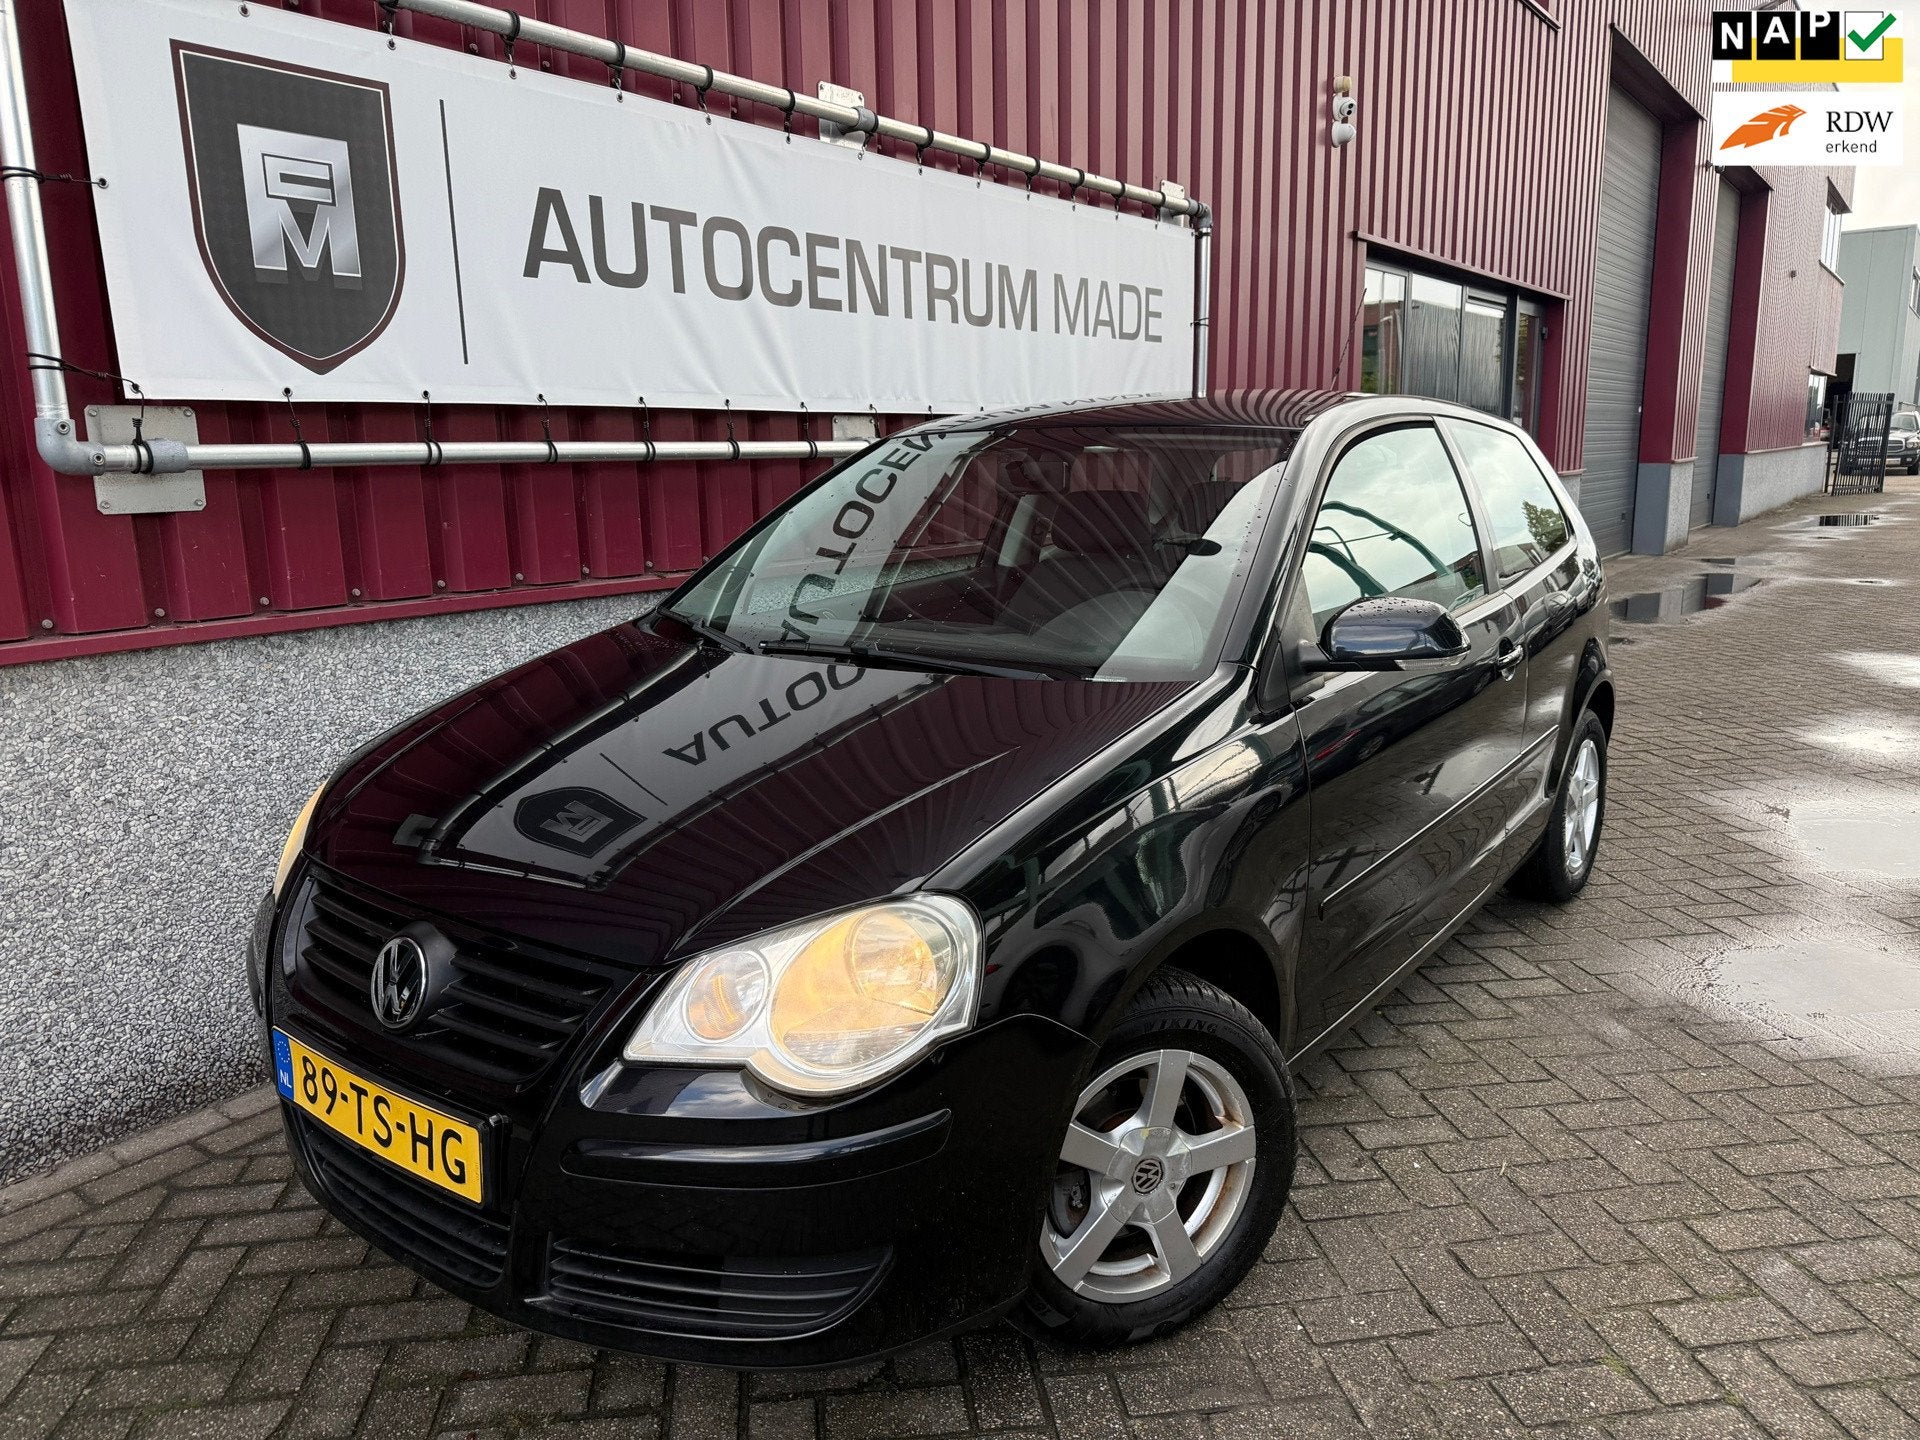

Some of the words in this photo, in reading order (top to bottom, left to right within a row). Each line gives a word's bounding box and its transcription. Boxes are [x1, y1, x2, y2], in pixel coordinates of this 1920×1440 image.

[522, 186, 1039, 332] AUTOCENTRUM
[1053, 272, 1164, 344] MADE
[279, 1068, 293, 1089] NL
[301, 1054, 467, 1185] 89-TS-HG
